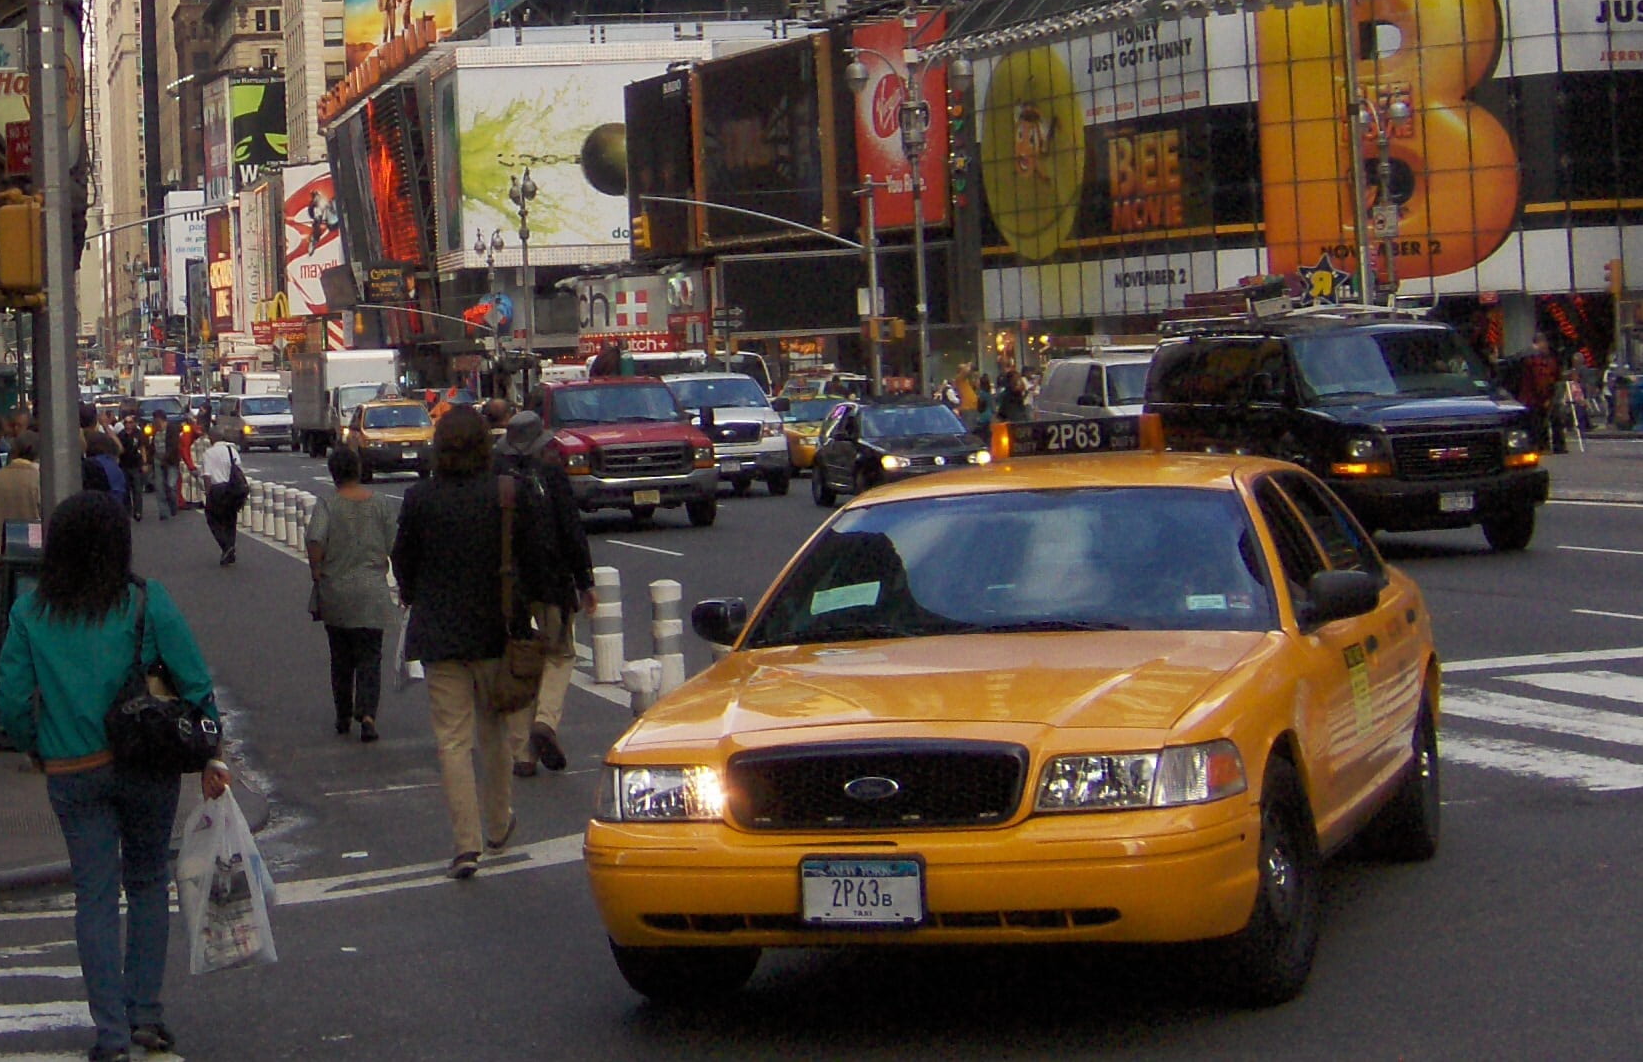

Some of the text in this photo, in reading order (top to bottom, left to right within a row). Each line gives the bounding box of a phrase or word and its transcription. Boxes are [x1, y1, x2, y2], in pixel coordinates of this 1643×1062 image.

[1116, 22, 1159, 47] HONEY
[1088, 37, 1193, 75] JUST GOT FUNNY
[1108, 128, 1179, 201] BEE
[1111, 192, 1184, 234] MOVIE
[1114, 267, 1188, 289] NOVEMBER 2
[1047, 422, 1101, 450] 2P63
